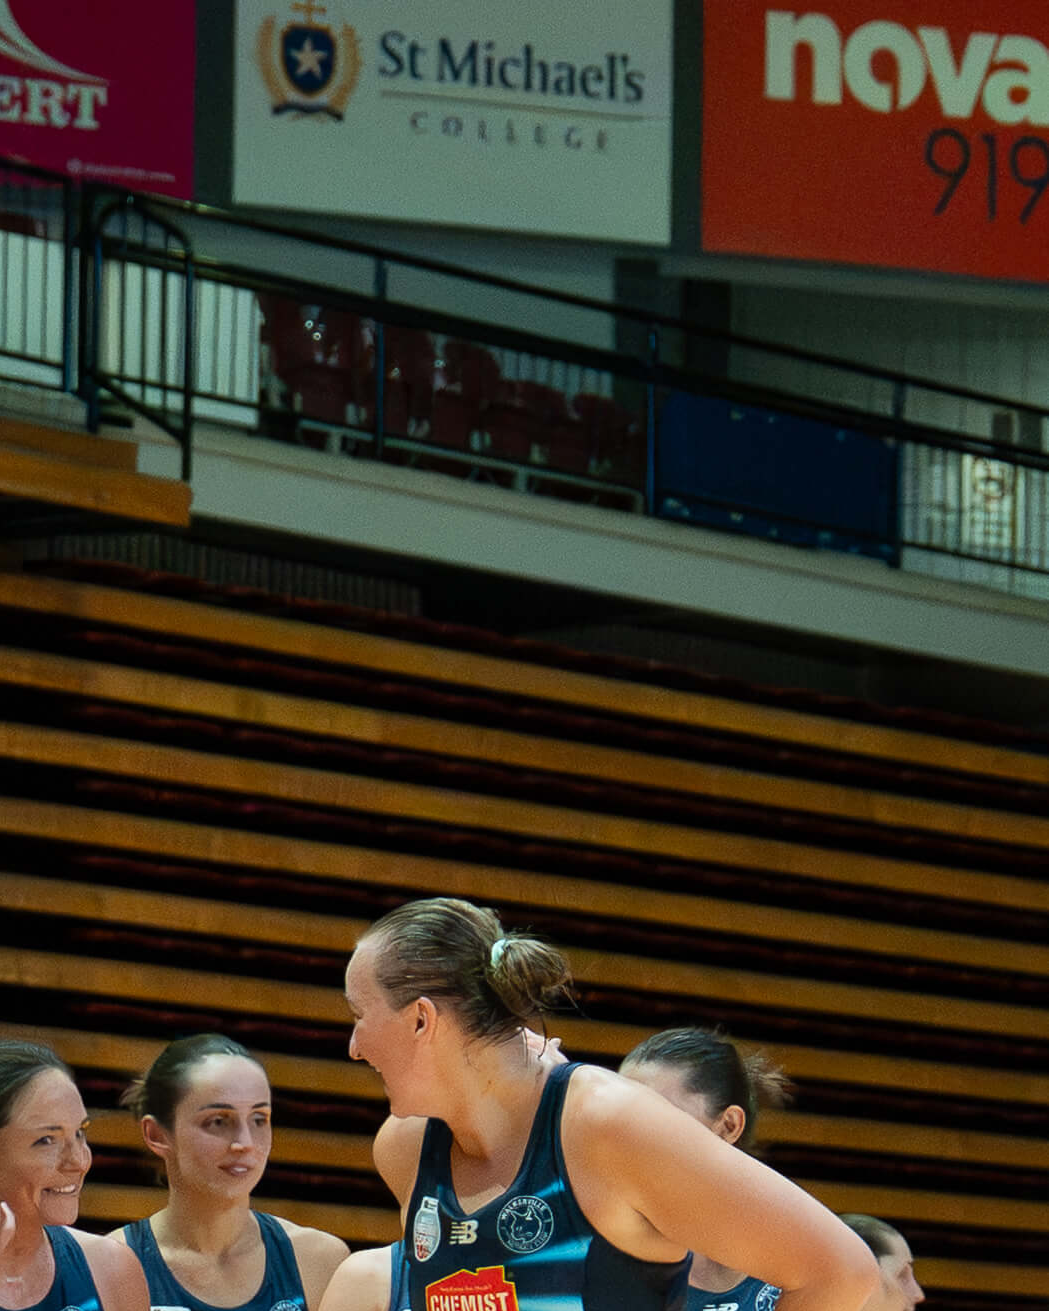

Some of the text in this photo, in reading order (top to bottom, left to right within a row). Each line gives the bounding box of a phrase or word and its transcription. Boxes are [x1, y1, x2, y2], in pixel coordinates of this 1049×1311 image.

[378, 30, 646, 103] St Michael's
[764, 10, 1049, 128] nova
[410, 111, 609, 150] COLLEGE
[925, 127, 1049, 225] 919
